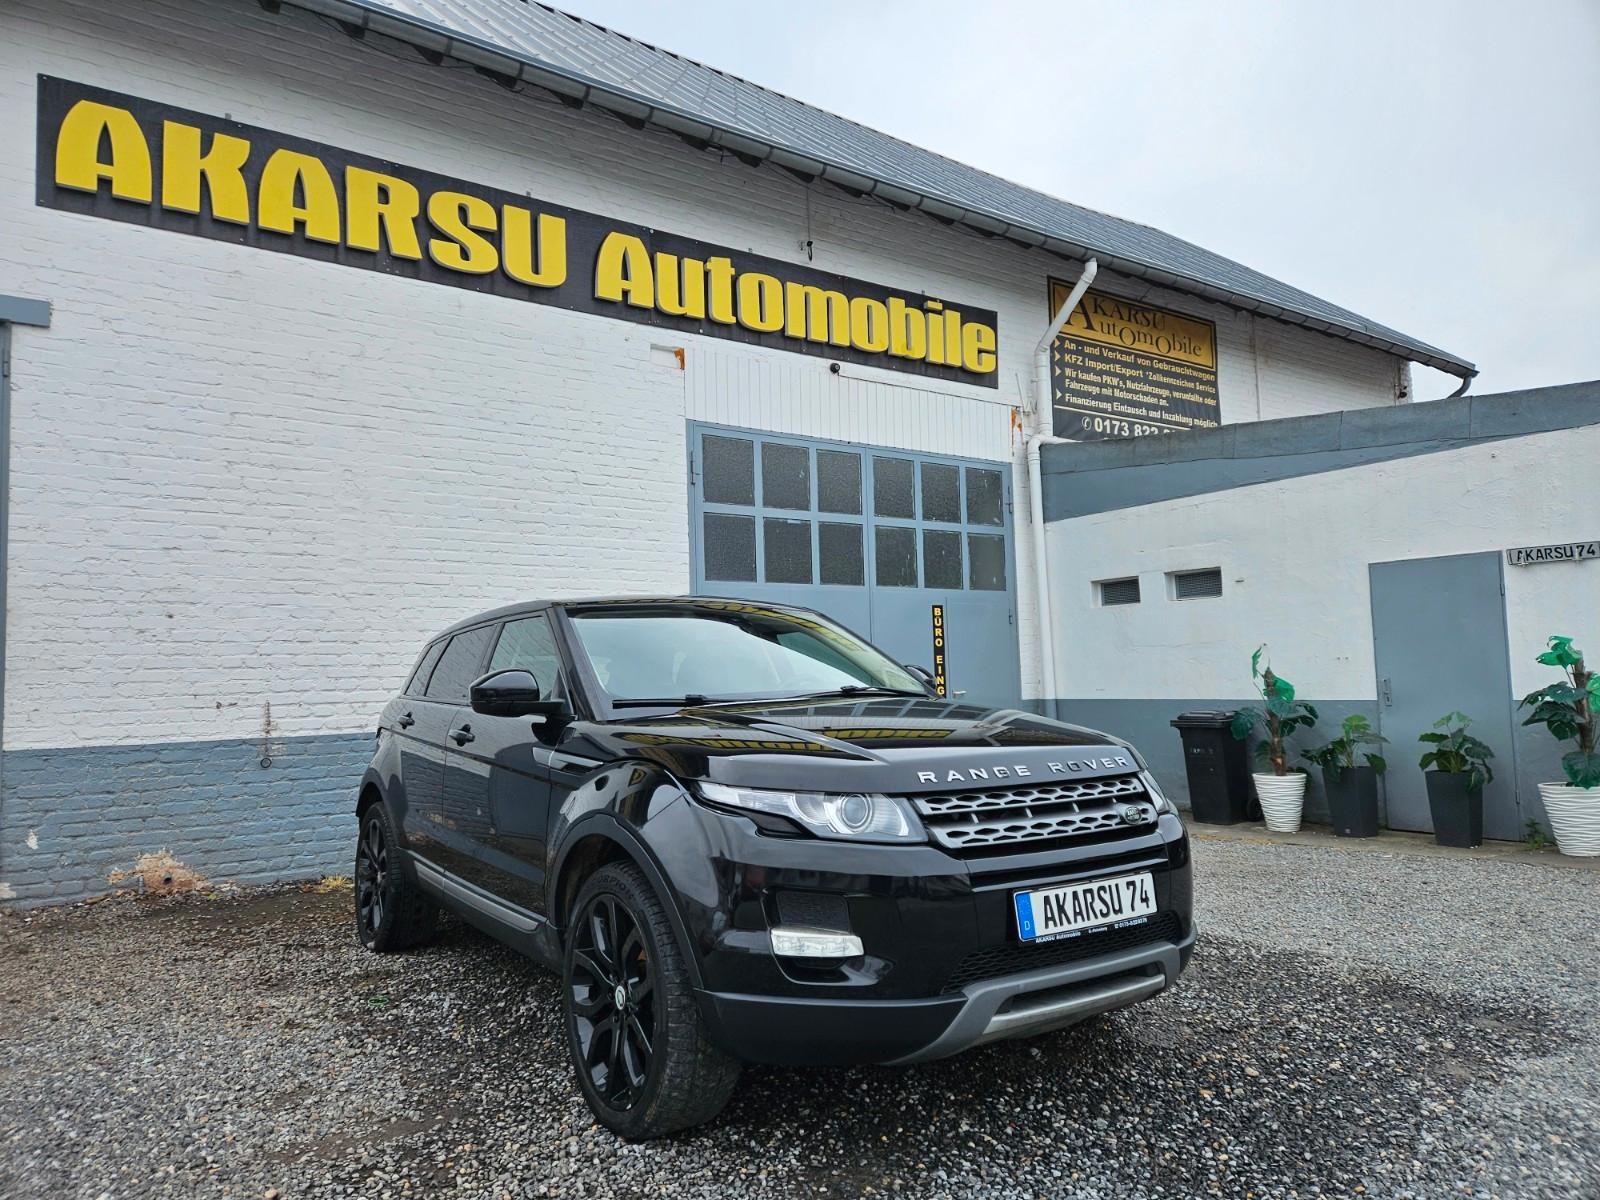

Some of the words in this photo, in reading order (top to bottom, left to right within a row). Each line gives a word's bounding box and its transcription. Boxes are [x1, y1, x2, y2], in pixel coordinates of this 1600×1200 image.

[55, 99, 568, 289] AKARSU
[594, 231, 997, 374] Automobile
[1064, 340, 1076, 350] An
[1084, 346, 1100, 355] und
[1102, 347, 1134, 363] Verkauf
[1137, 358, 1151, 367] von
[1153, 360, 1216, 381] Gebrauchtwagen
[1064, 353, 1083, 366] KFZ
[1085, 358, 1143, 378] Import/Export
[1196, 382, 1216, 394] Service
[1065, 367, 1077, 378] Wir
[1078, 370, 1101, 383] kaufen
[1204, 397, 1217, 406] oder
[1065, 379, 1100, 395] Fahrzeuge
[1101, 387, 1113, 396] mit
[1114, 388, 1159, 405] Motorschaden
[1065, 393, 1112, 411] Finanzierung
[1113, 402, 1147, 416] Eintausch
[1149, 409, 1161, 419] und
[1162, 411, 1193, 426] Inzahlung
[1193, 417, 1218, 428] möglich
[1094, 417, 1130, 436] 0173
[917, 764, 1031, 784] RANGE
[1048, 756, 1129, 774] ROVER
[1024, 920, 1031, 931] D
